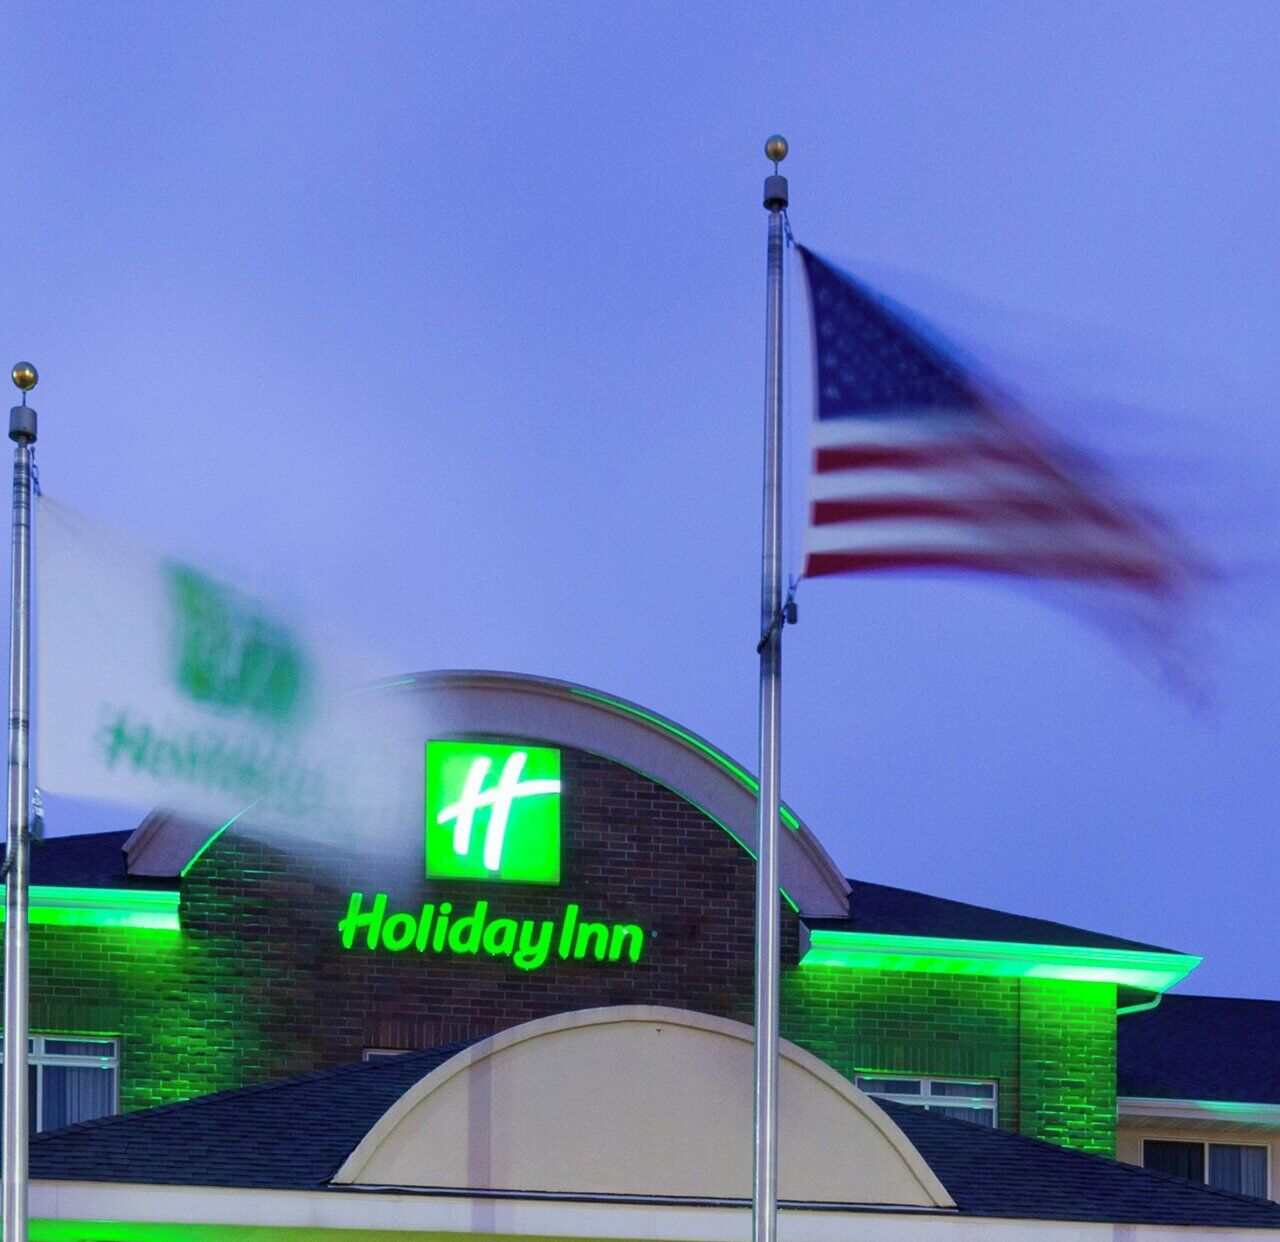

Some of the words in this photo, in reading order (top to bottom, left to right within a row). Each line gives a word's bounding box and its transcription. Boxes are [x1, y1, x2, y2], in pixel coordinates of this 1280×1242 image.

[437, 751, 561, 871] H
[338, 892, 554, 969] Holiday
[559, 904, 643, 962] Inn
